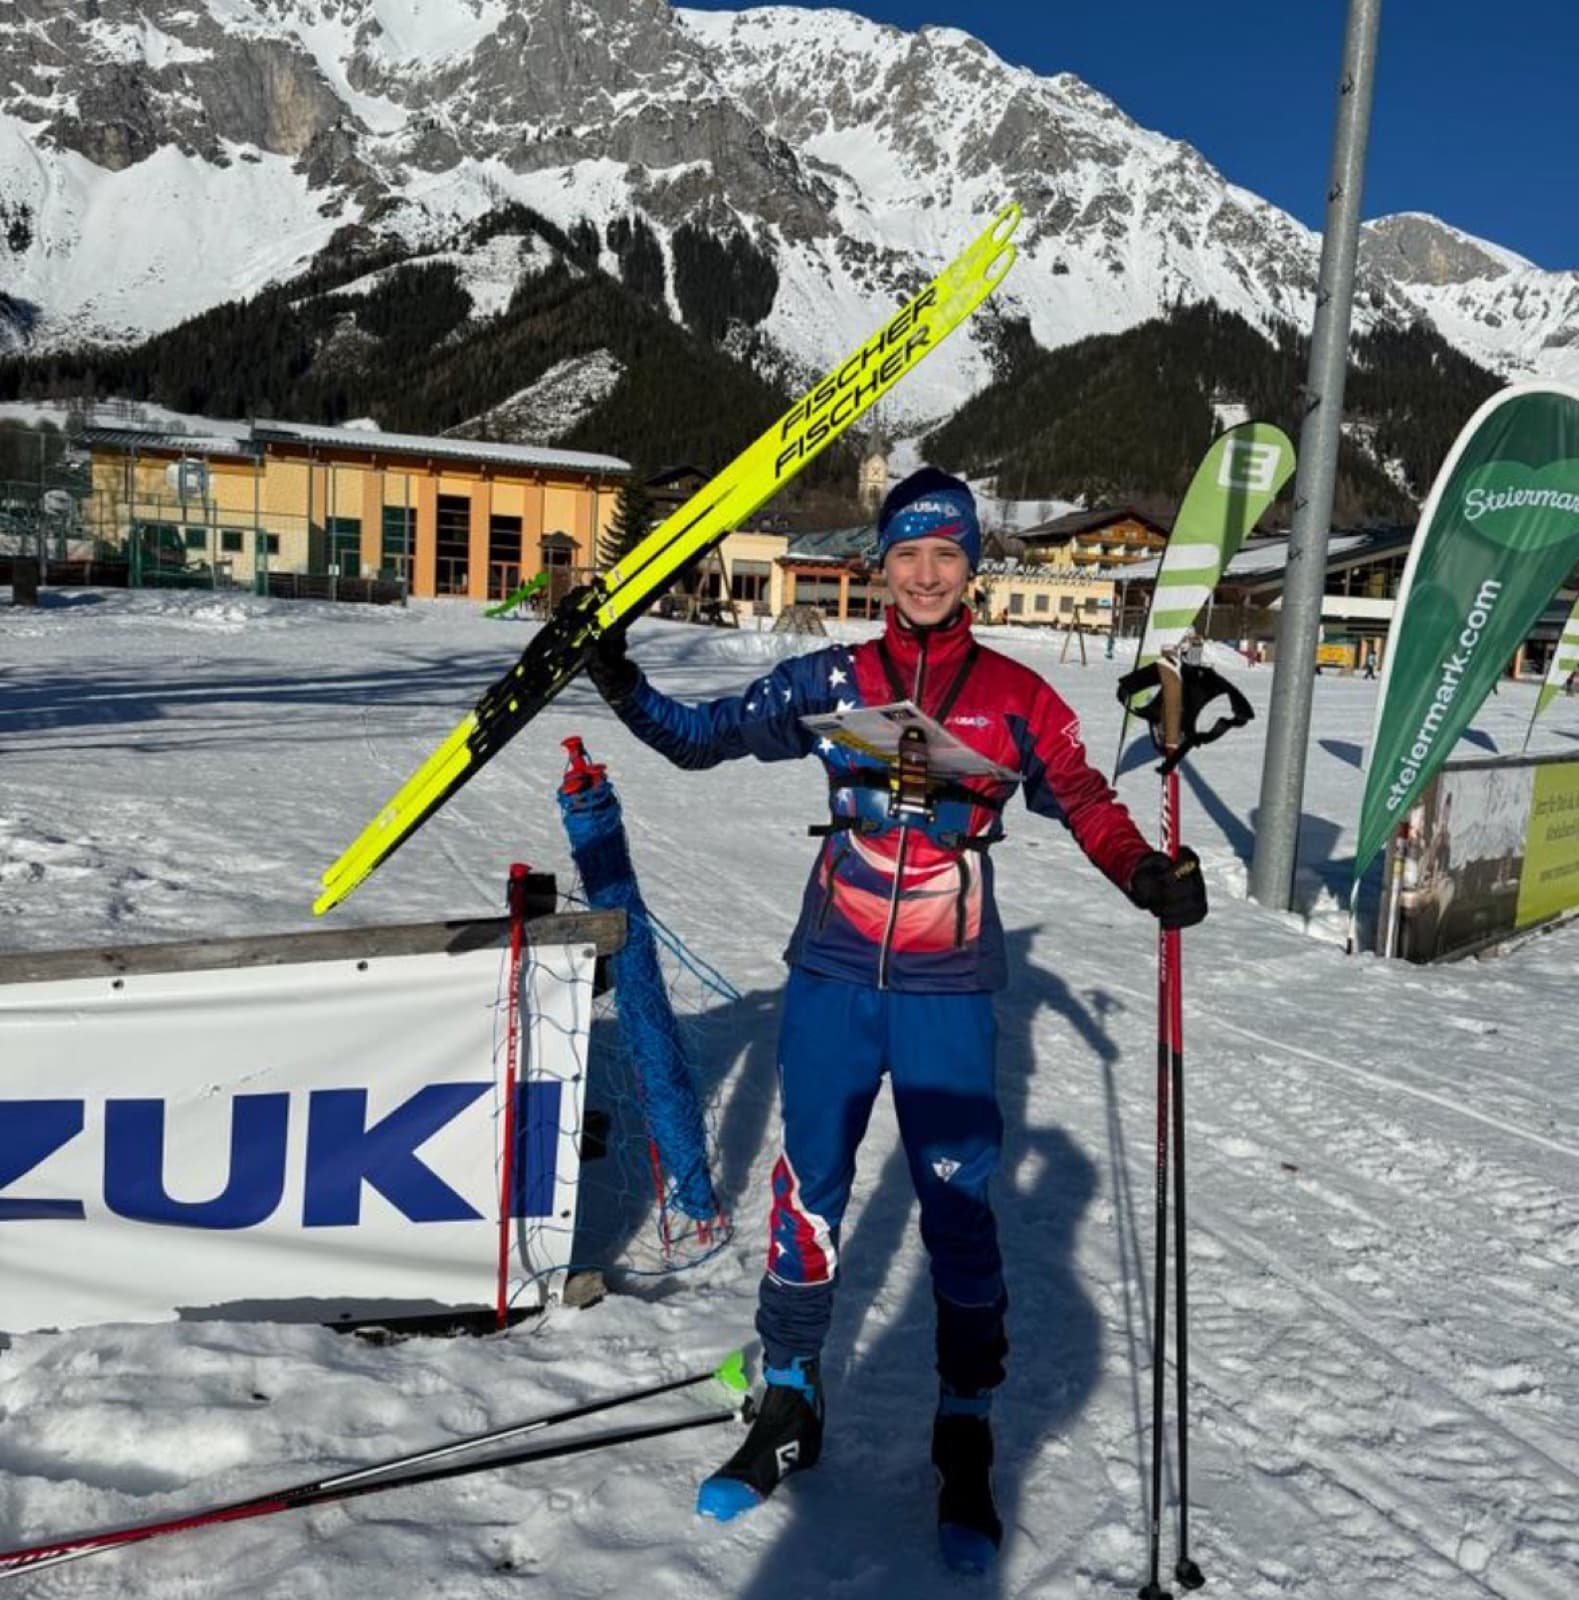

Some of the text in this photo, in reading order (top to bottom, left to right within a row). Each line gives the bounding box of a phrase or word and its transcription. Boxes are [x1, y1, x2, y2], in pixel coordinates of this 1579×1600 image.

[774, 325, 931, 479] FISCHER
[781, 287, 937, 442] FISCHER
[914, 501, 941, 513] USA
[1386, 579, 1502, 812] steiermark.com
